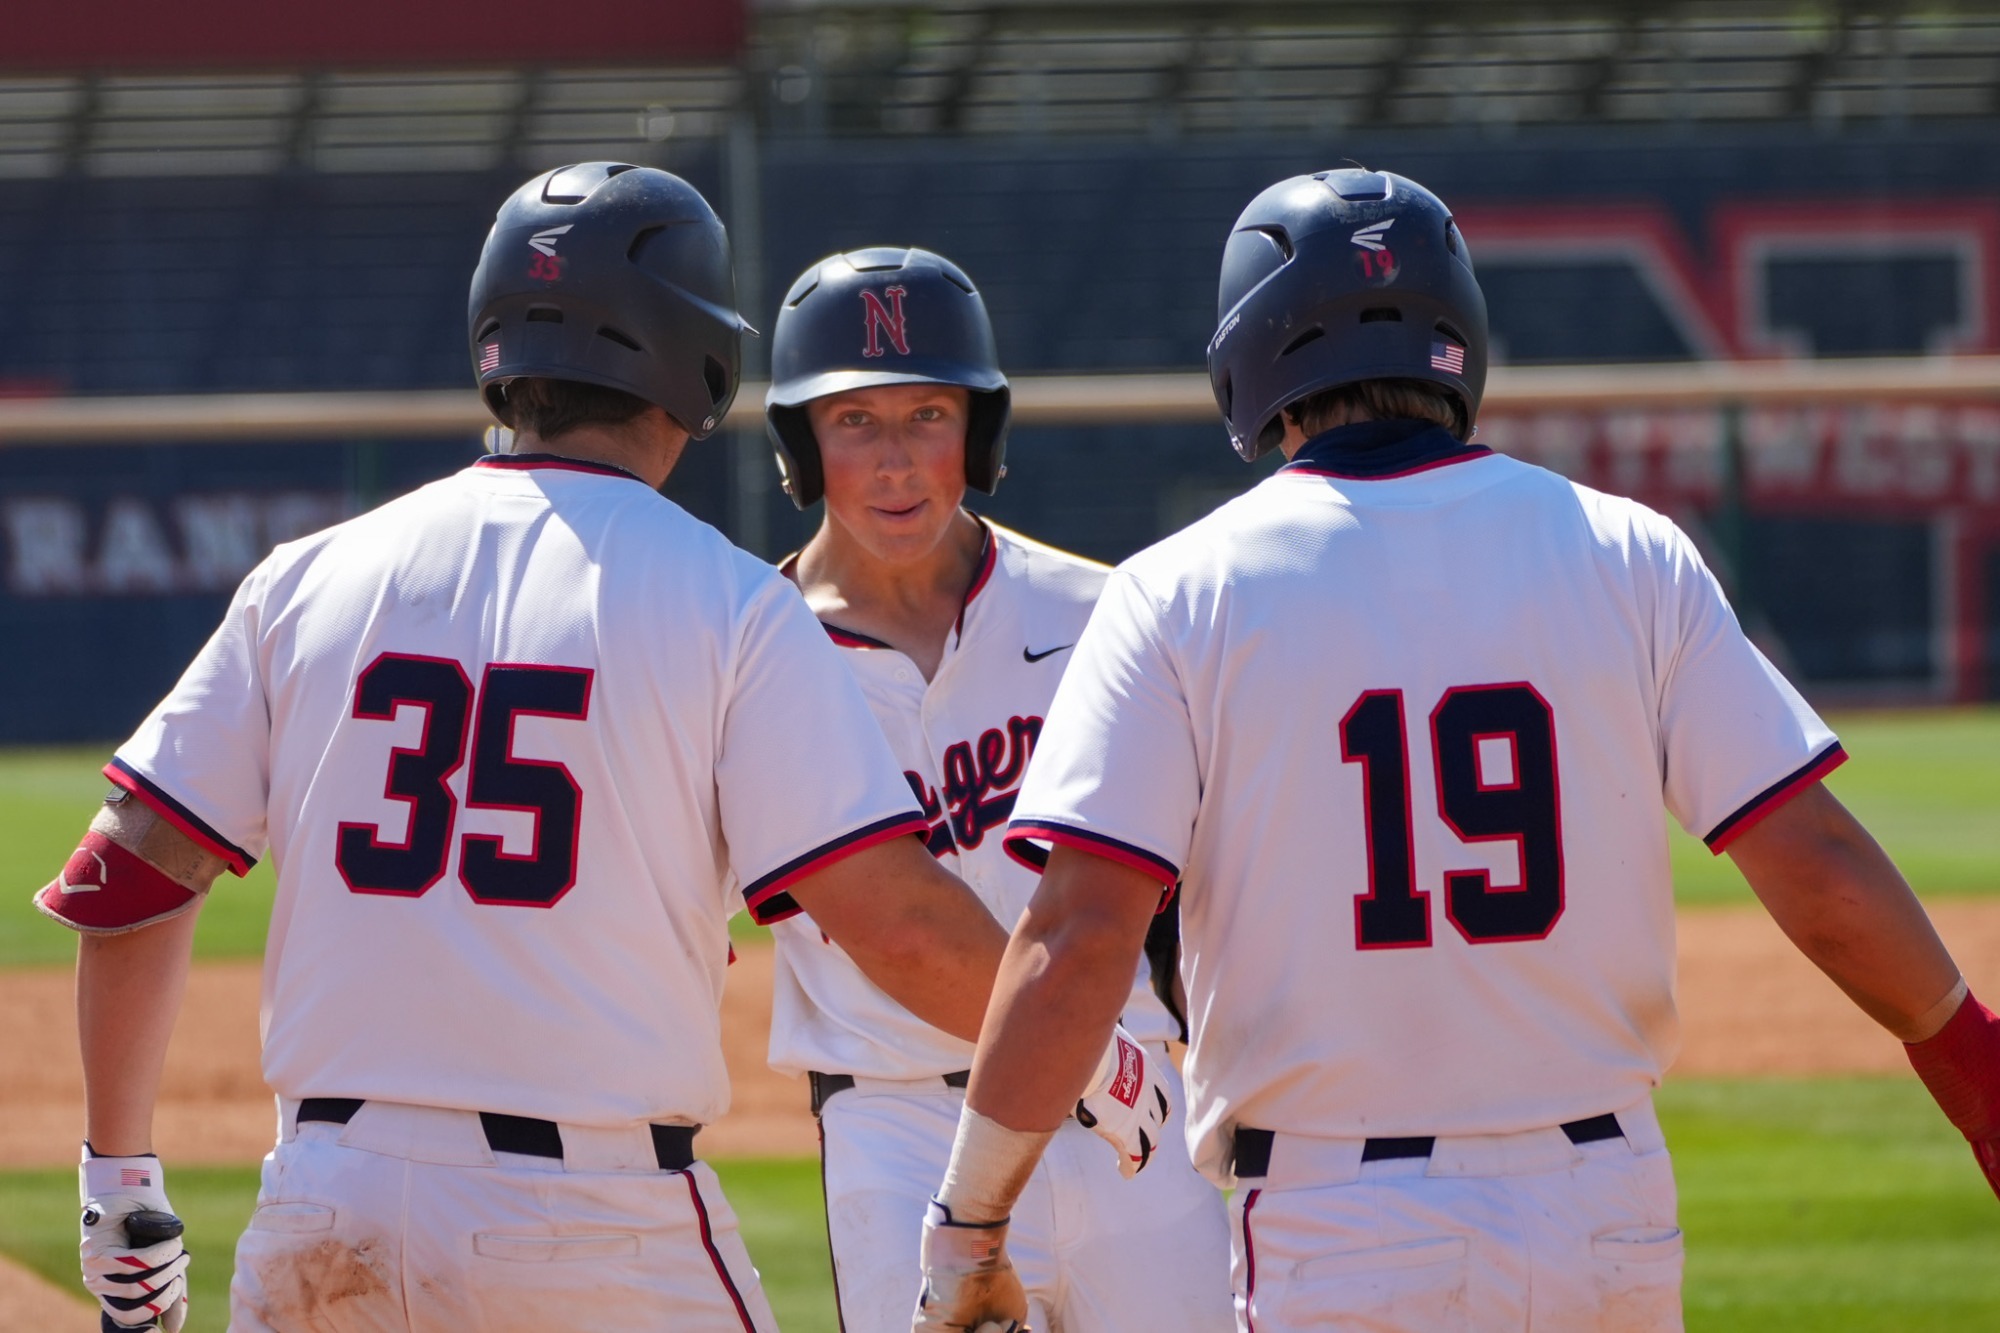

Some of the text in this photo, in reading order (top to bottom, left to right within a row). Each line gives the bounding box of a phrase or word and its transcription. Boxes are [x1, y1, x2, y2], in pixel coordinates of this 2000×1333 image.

[529, 252, 561, 281] 35
[1361, 249, 1393, 278] 19
[859, 285, 911, 358] N
[1214, 312, 1240, 350] EASTON
[335, 651, 595, 909] 35
[1338, 681, 1566, 951] 19
[1122, 1043, 1138, 1100] Rawlings
